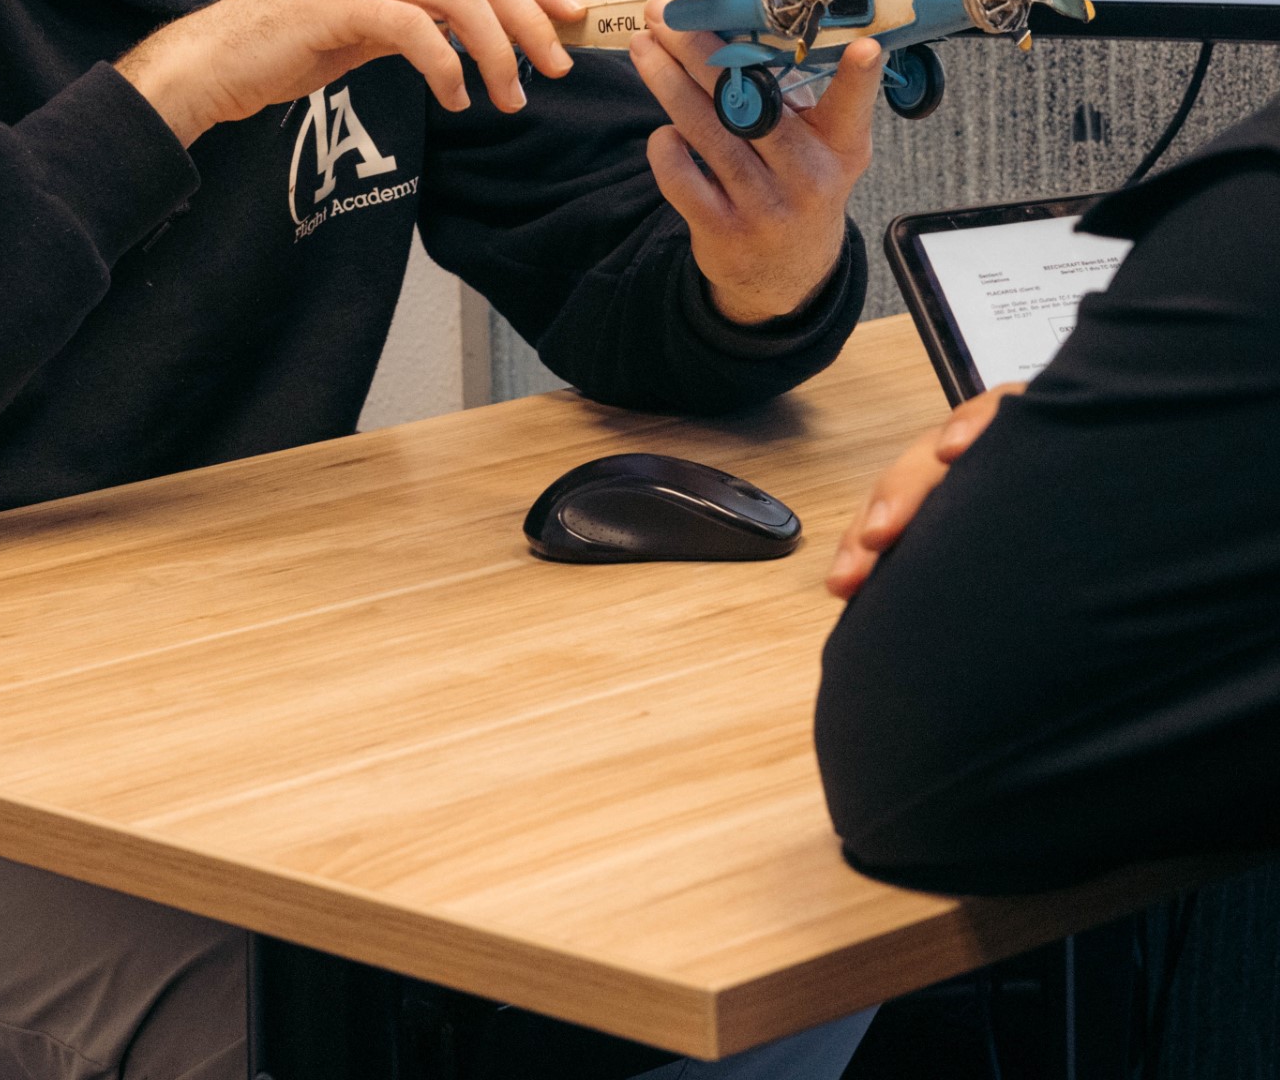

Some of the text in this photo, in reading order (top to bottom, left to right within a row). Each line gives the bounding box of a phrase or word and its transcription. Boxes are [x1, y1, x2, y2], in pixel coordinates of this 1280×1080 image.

[598, 16, 640, 33] OK-FOL
[294, 176, 419, 244] Flight Academy
